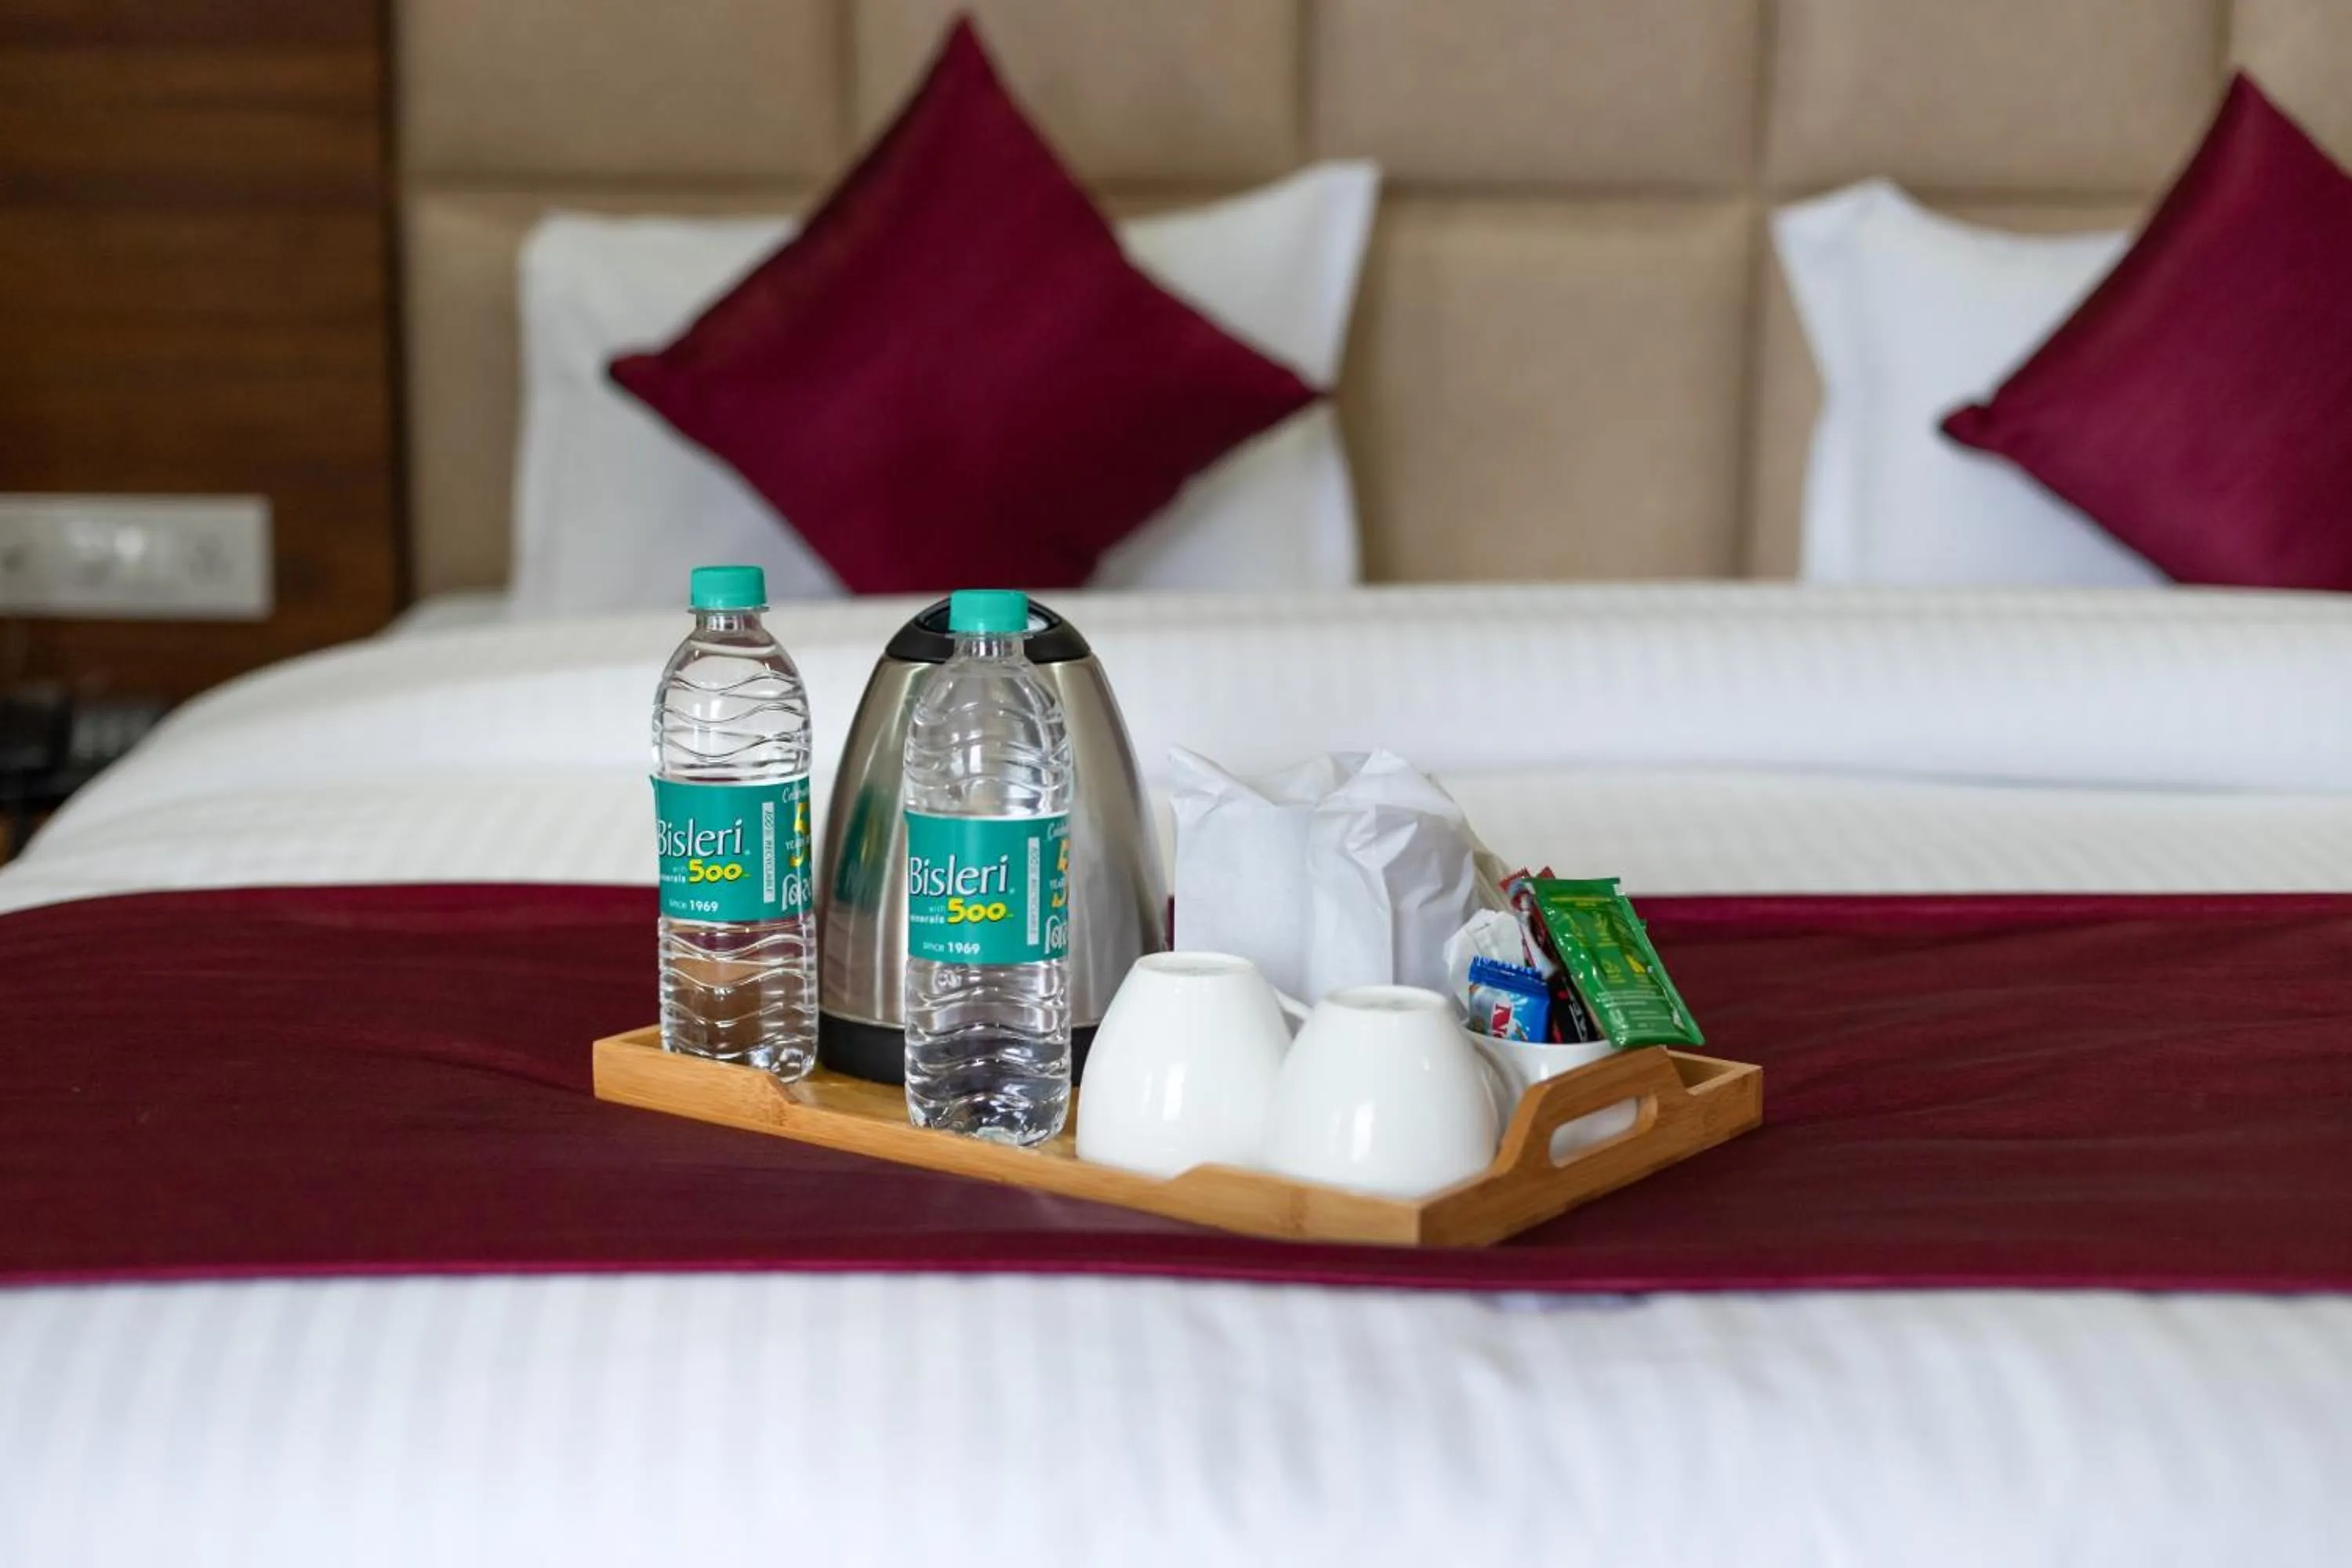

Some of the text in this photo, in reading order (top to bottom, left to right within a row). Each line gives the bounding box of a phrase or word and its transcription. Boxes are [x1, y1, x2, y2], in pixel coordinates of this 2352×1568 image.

[658, 818, 743, 857] Bisleri
[689, 858, 742, 883] 500
[909, 854, 1009, 896] Bisleri
[689, 899, 719, 913] 1969
[947, 897, 1007, 924] 500
[947, 942, 980, 955] 1969
